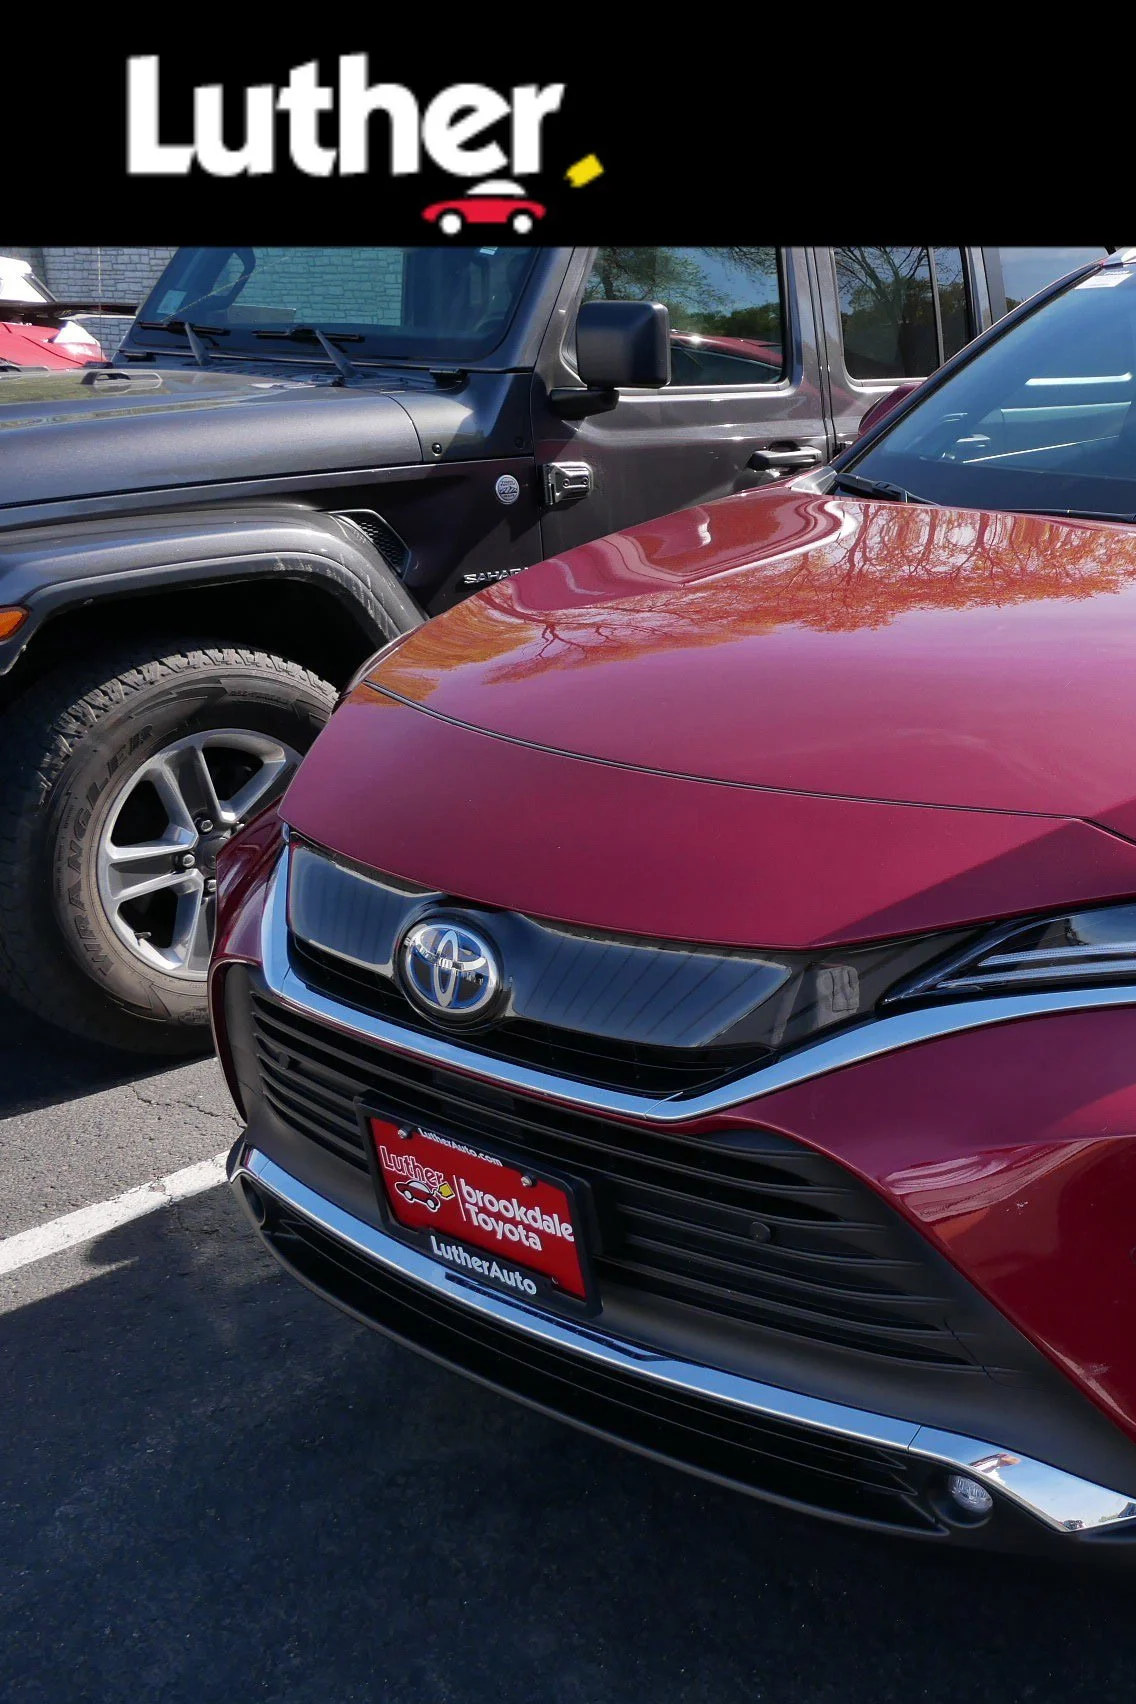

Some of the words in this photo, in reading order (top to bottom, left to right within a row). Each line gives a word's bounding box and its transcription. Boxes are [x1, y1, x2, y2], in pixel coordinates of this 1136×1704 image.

[463, 567, 529, 584] SAHAR
[379, 1145, 444, 1189] Luther
[417, 1127, 504, 1168] LutherAuto.com
[460, 1178, 575, 1242] brookdale
[465, 1204, 543, 1251] Toyota
[430, 1235, 538, 1296] LutherAuto
